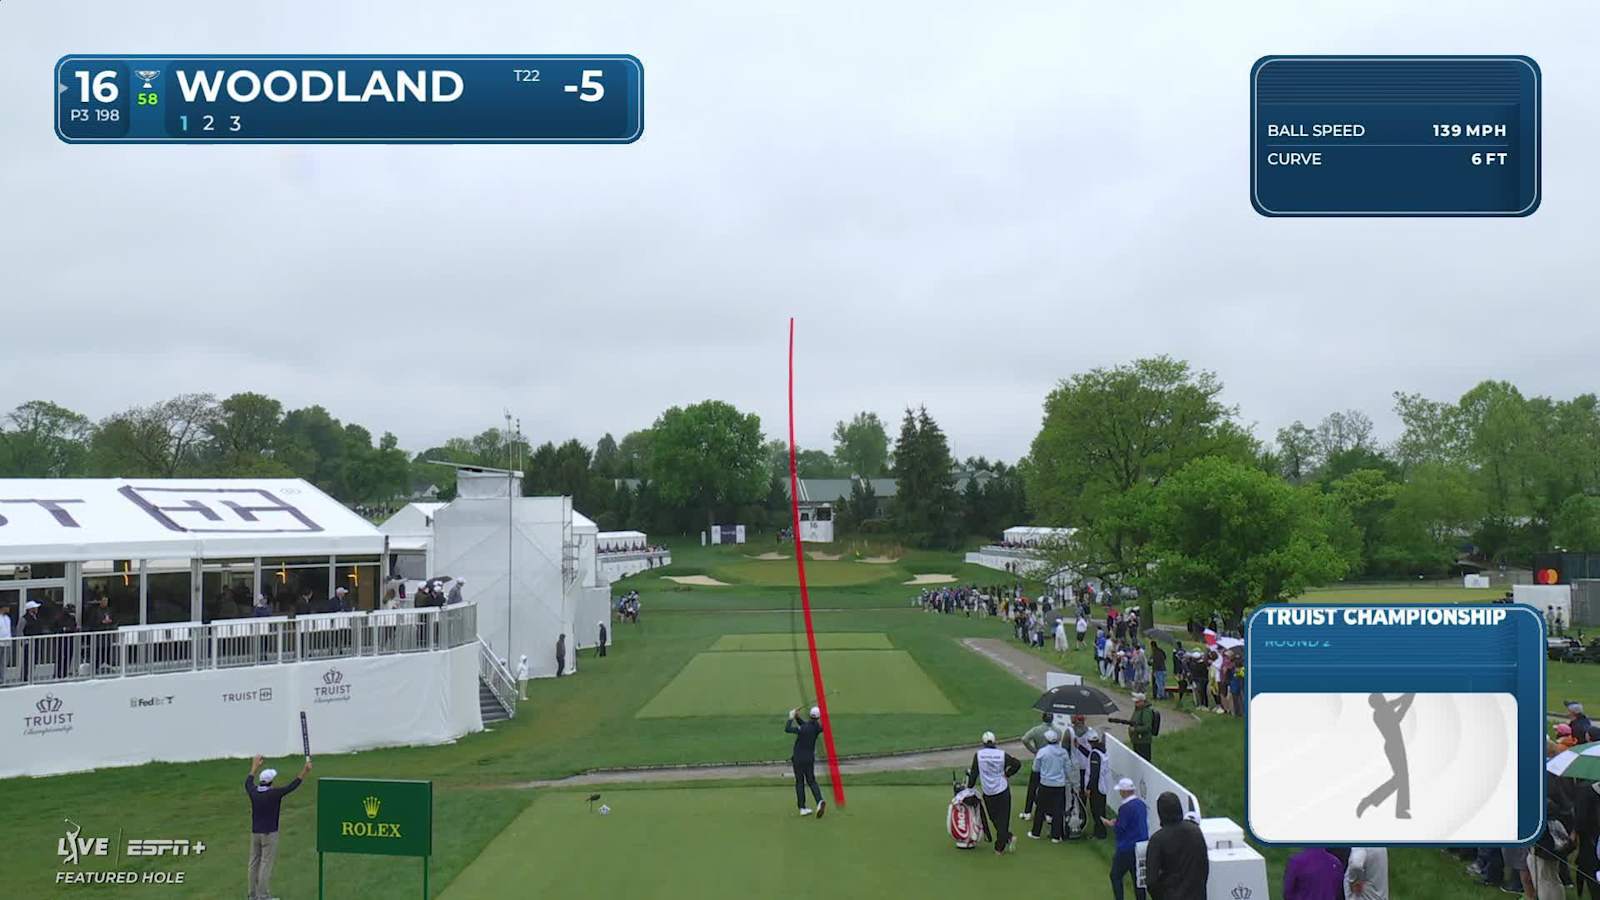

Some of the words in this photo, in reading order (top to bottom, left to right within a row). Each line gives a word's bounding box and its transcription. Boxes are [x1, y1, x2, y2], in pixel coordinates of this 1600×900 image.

[222, 691, 257, 703] TRUIST
[314, 684, 352, 697] TRUIST
[24, 712, 74, 727] TRUIST
[341, 821, 402, 838] ROLEX
